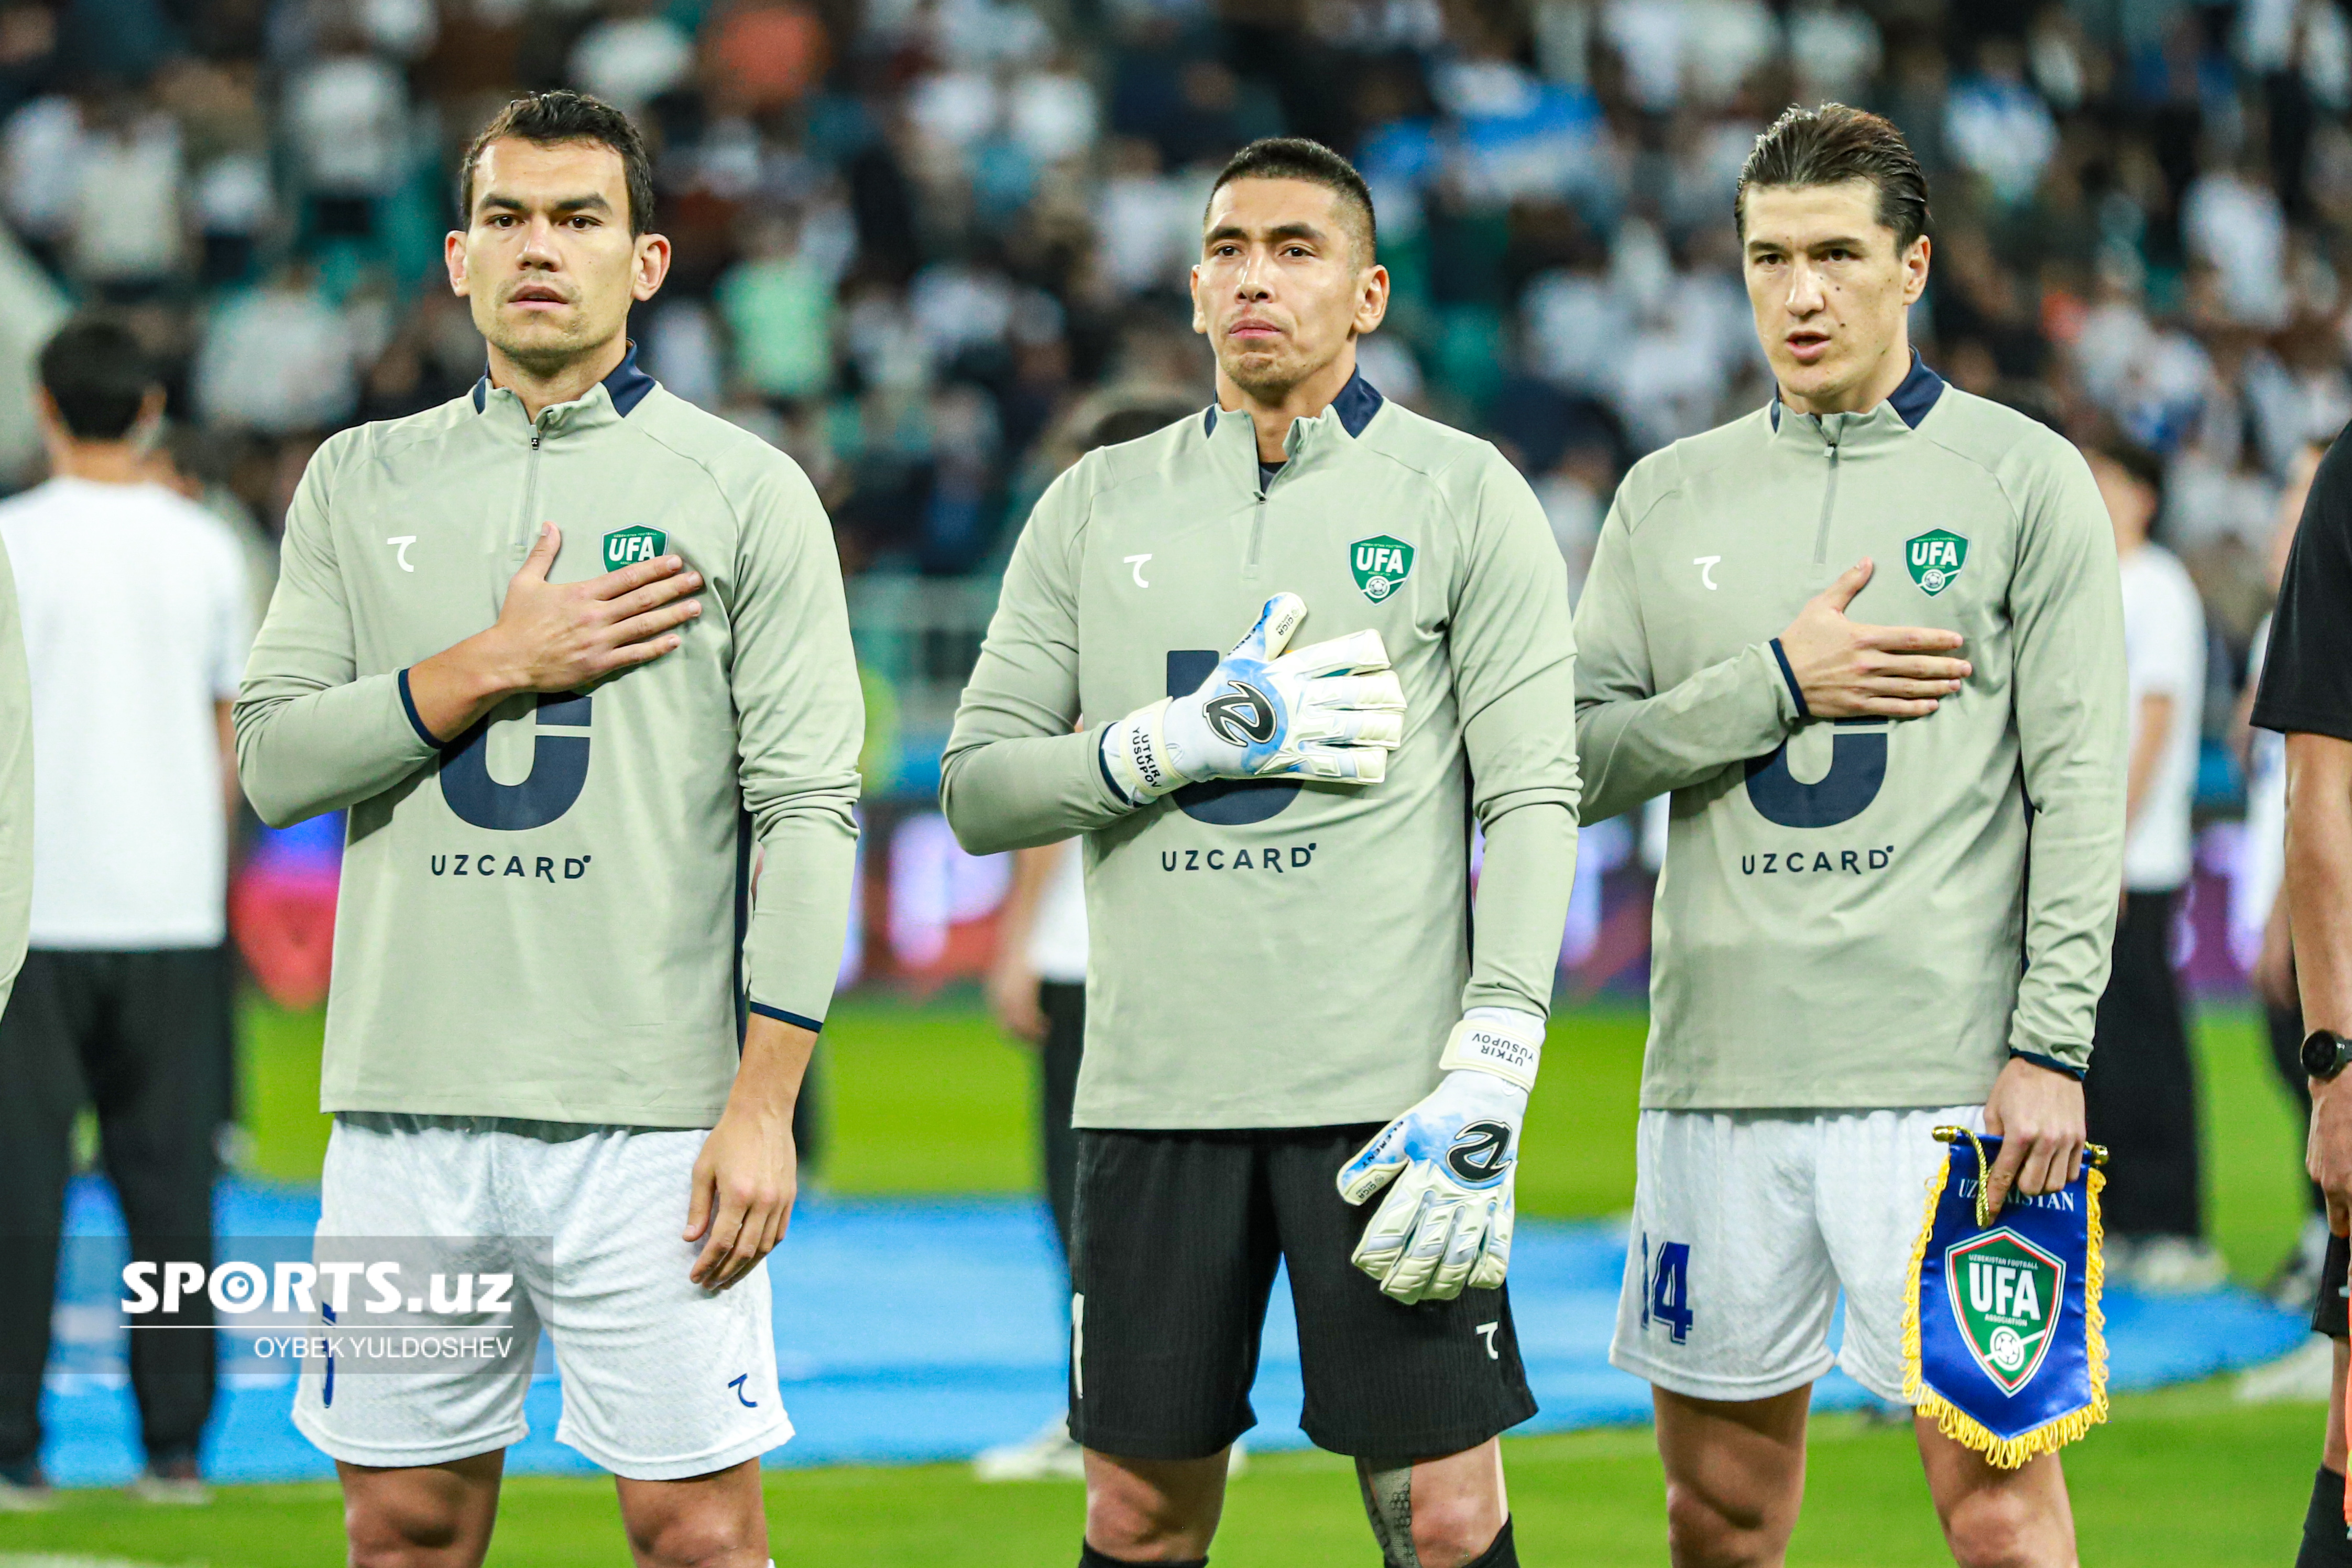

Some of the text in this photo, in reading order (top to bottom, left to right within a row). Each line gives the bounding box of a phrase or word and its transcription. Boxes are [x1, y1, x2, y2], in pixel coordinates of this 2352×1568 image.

[609, 536, 655, 561] UFA
[1356, 546, 1404, 574] UFA
[1911, 541, 1958, 566] UFA
[1132, 726, 1162, 787] YUSUPOV
[1141, 734, 1161, 778] UTKIR
[431, 854, 591, 883] UZCARD
[1162, 842, 1317, 873] UZCARD
[1742, 845, 1894, 875] UZCARD
[1472, 1033, 1533, 1062] YUSUPOV
[1481, 1045, 1523, 1067] UTKIR
[1968, 1254, 2038, 1270] UZBEKISTAN FOOTBALL
[1969, 1262, 2041, 1321] UFA
[1984, 1313, 2028, 1327] ASSOCIATION
